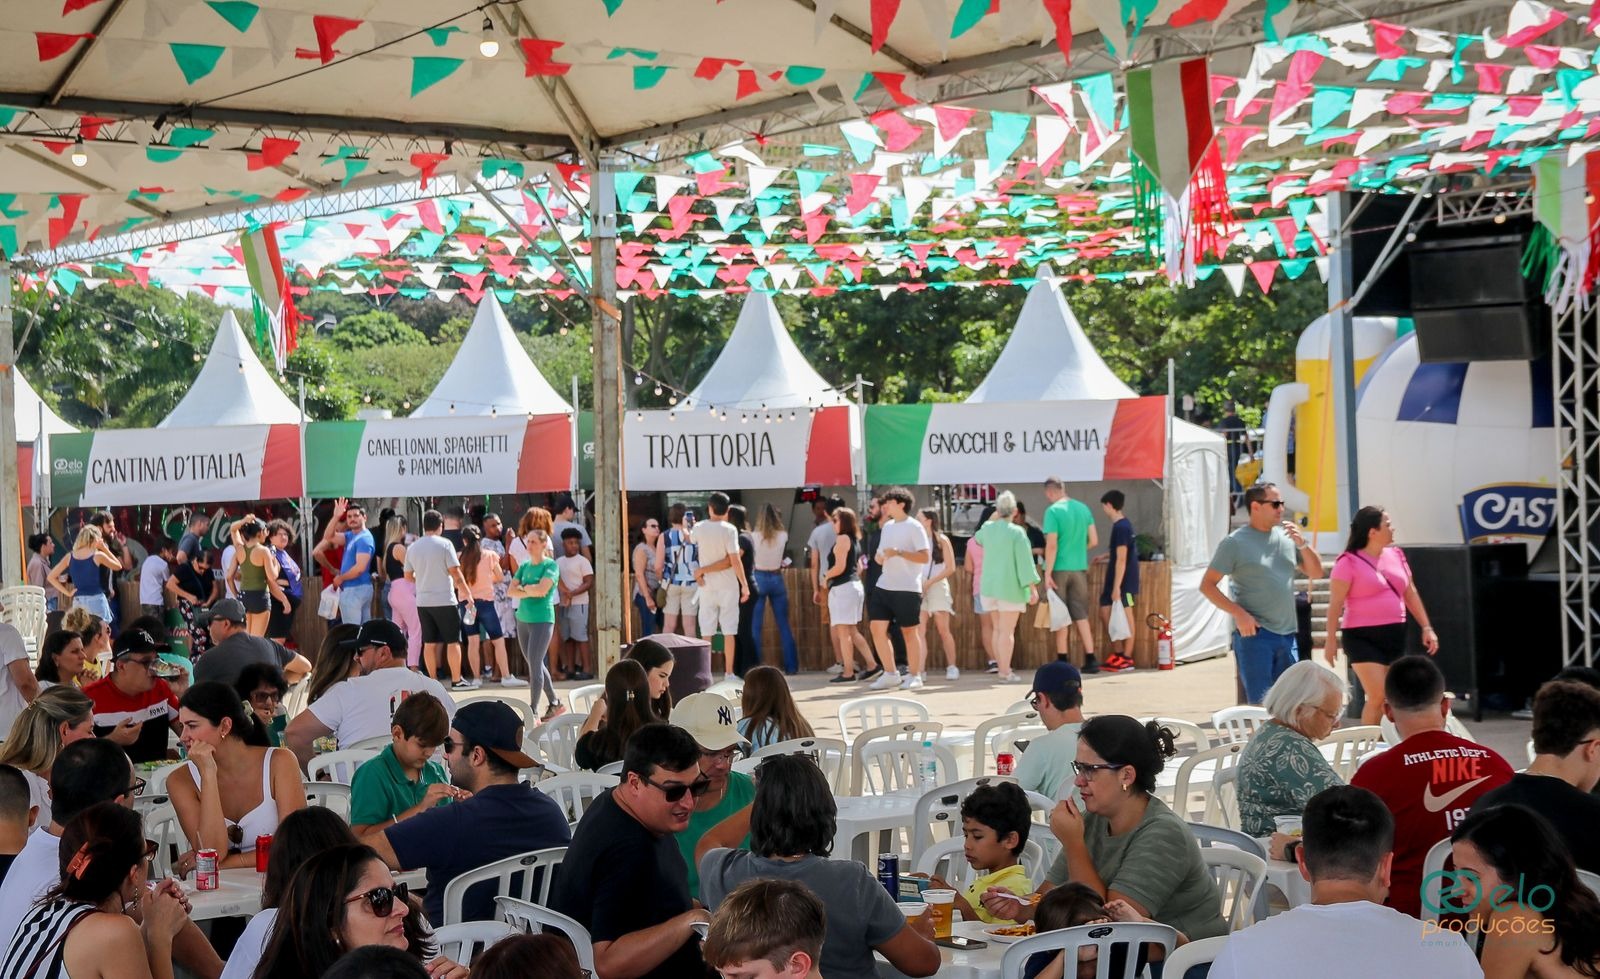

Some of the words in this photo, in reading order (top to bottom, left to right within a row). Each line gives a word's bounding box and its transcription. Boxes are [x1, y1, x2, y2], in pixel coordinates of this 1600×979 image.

[367, 438, 441, 457] CANELLONNI,
[444, 434, 508, 455] SPAGHETTI
[643, 431, 776, 469] TRATTORIA
[928, 431, 998, 455] GNOCCHI
[1004, 430, 1016, 453] &
[1023, 428, 1100, 453] LASANHA
[91, 456, 168, 484] CANTINA
[174, 452, 246, 481] D'ITALIA
[398, 459, 406, 476] &
[411, 456, 483, 476] PARMIGIANA
[1403, 748, 1460, 766] ATHLETIC
[1432, 757, 1482, 785] NIKE
